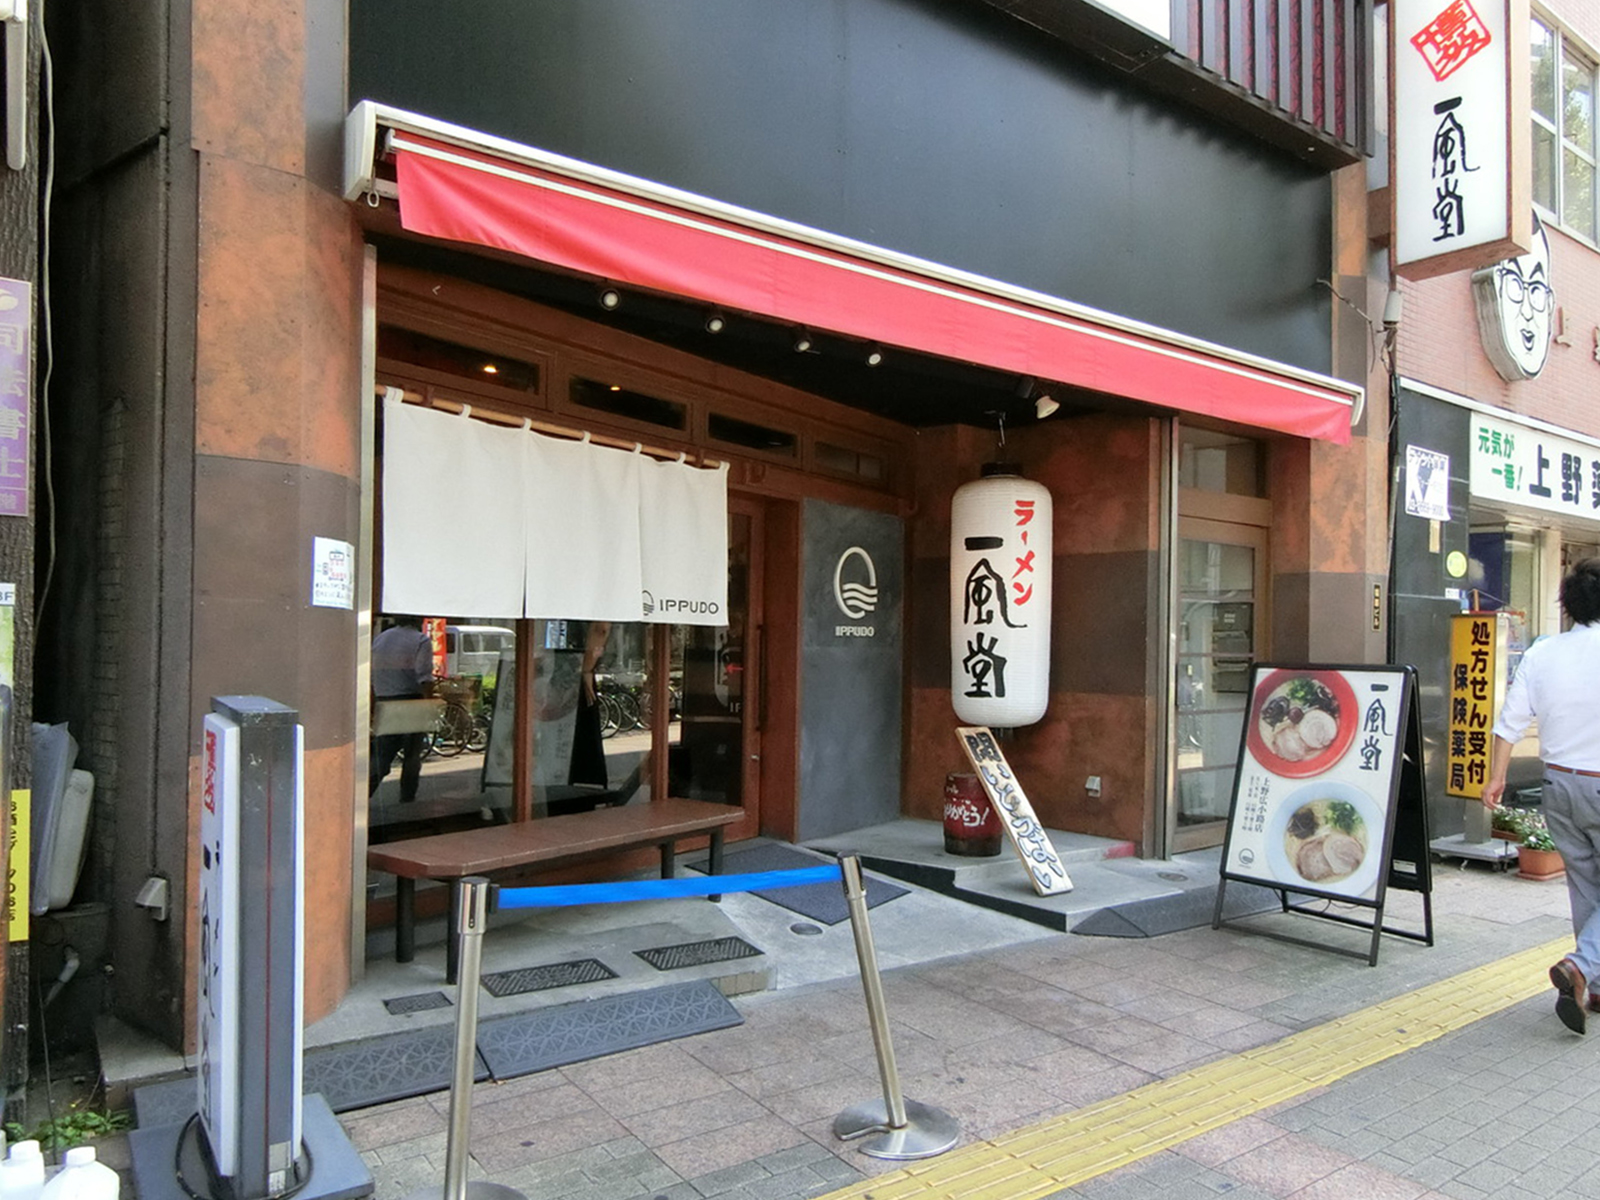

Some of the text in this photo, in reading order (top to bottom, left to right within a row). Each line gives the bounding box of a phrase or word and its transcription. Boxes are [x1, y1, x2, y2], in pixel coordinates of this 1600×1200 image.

[1431, 96, 1480, 241] 一風堂
[1478, 426, 1515, 459] 元気が
[1010, 500, 1035, 606] ラーメン
[659, 599, 719, 615] IPPUDO
[835, 626, 875, 637] IPPUDO
[962, 536, 1028, 698] 一風堂
[1359, 683, 1393, 771] 一風堂
[1450, 663, 1468, 791] 保険薬局
[1467, 621, 1490, 785] 処方せん受付
